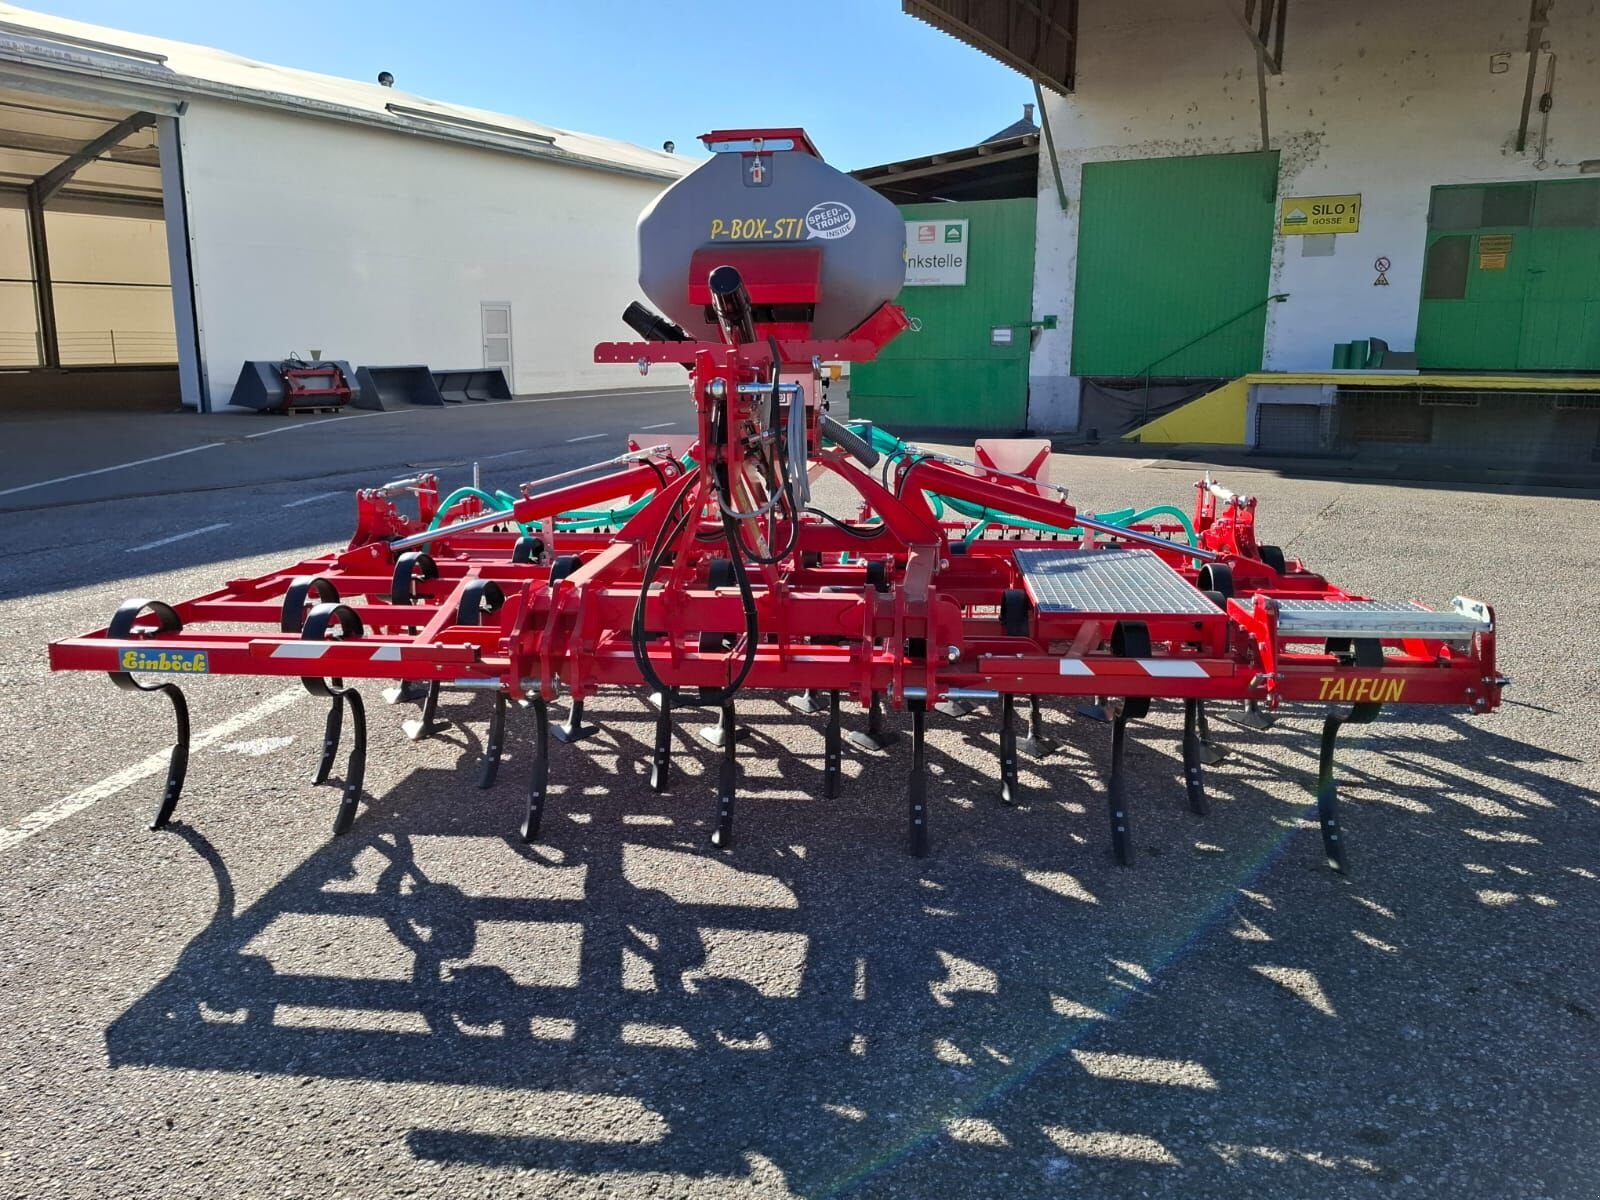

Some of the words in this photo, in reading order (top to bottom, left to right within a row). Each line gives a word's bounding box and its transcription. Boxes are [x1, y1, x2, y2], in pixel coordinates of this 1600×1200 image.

[808, 208, 842, 225] SPEED-
[1312, 203, 1345, 216] SILO
[1350, 202, 1356, 214] 1
[710, 218, 804, 240] P-BOX-STI
[815, 212, 850, 231] TRONIC
[1312, 217, 1342, 225] GOSSE
[1349, 216, 1356, 224] B
[907, 253, 963, 269] nkstelle
[122, 650, 206, 672] Einböck
[1318, 677, 1406, 702] TAIFUN
